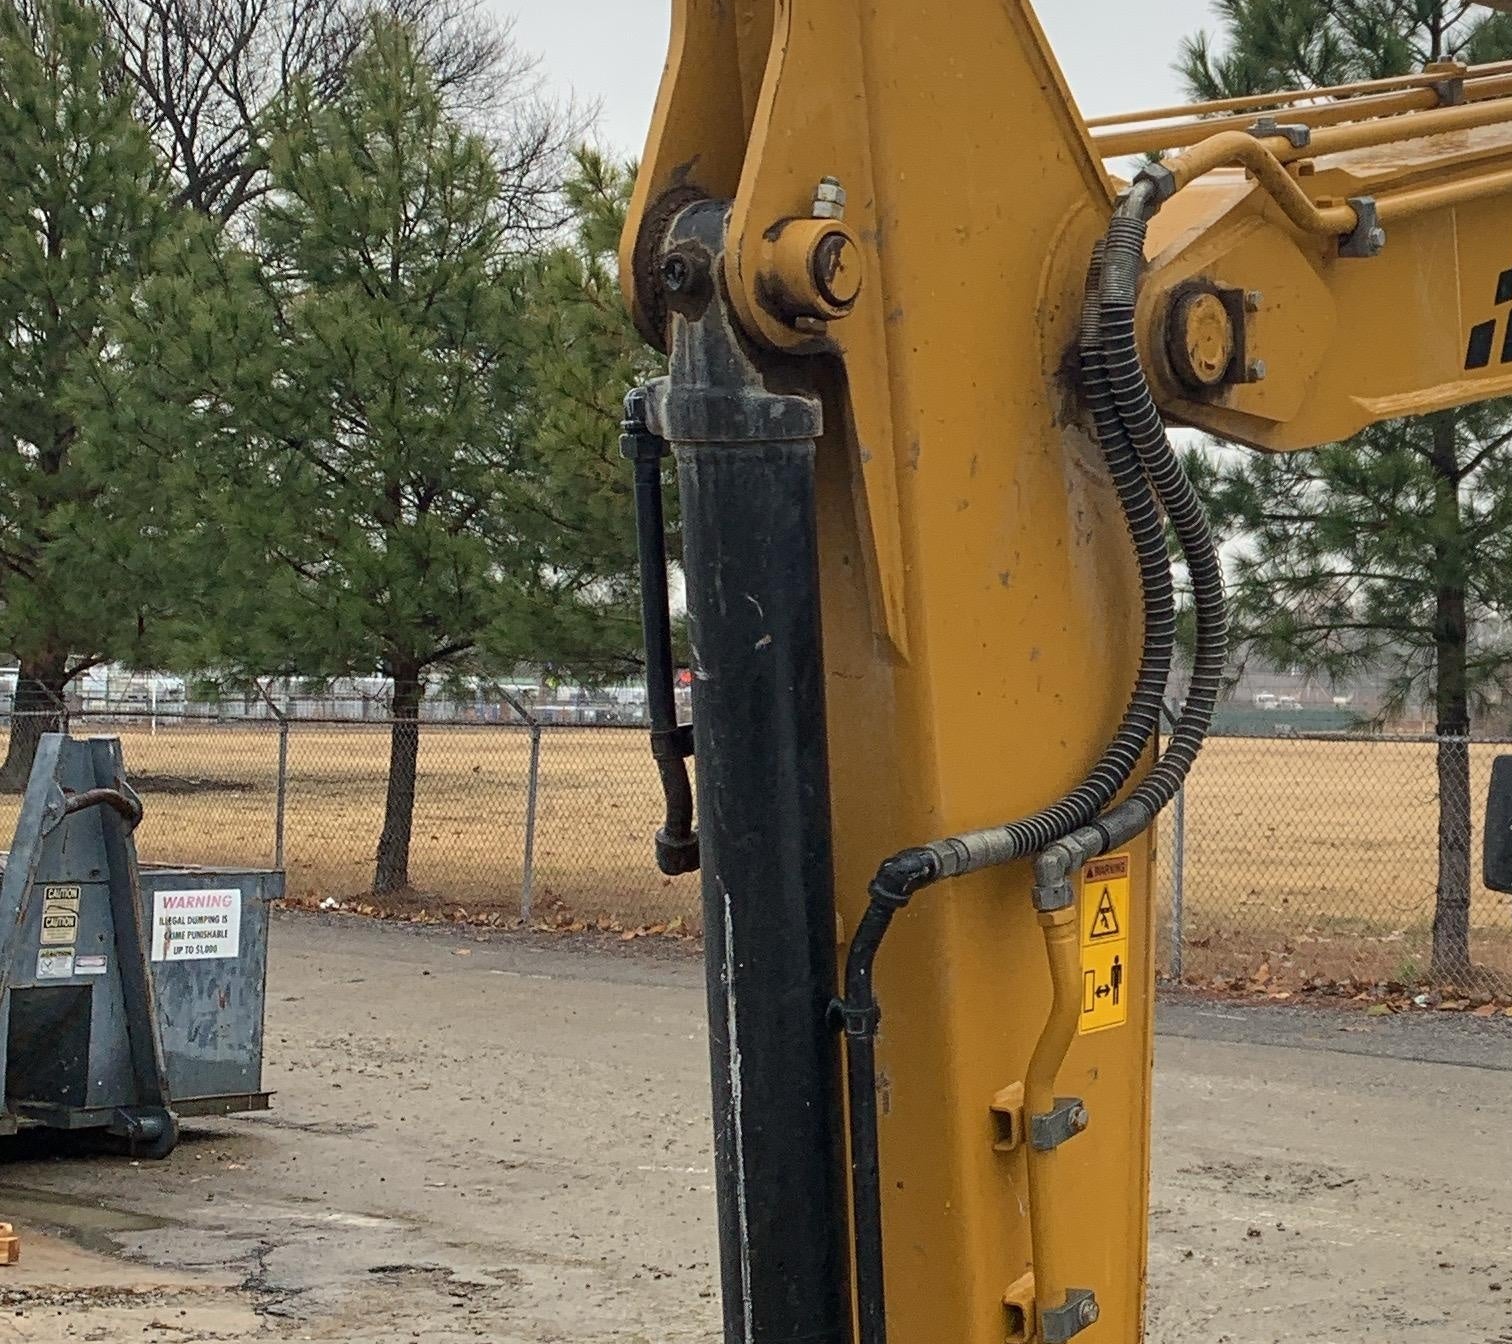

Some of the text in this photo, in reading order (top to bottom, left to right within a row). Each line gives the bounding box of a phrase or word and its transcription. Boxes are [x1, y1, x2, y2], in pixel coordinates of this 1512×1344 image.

[48, 888, 78, 899] CAUTION
[163, 895, 232, 909] WARNING
[45, 917, 75, 927] CAUTION
[187, 915, 220, 925] DUMPING
[187, 929, 228, 940] PUNISHABLE
